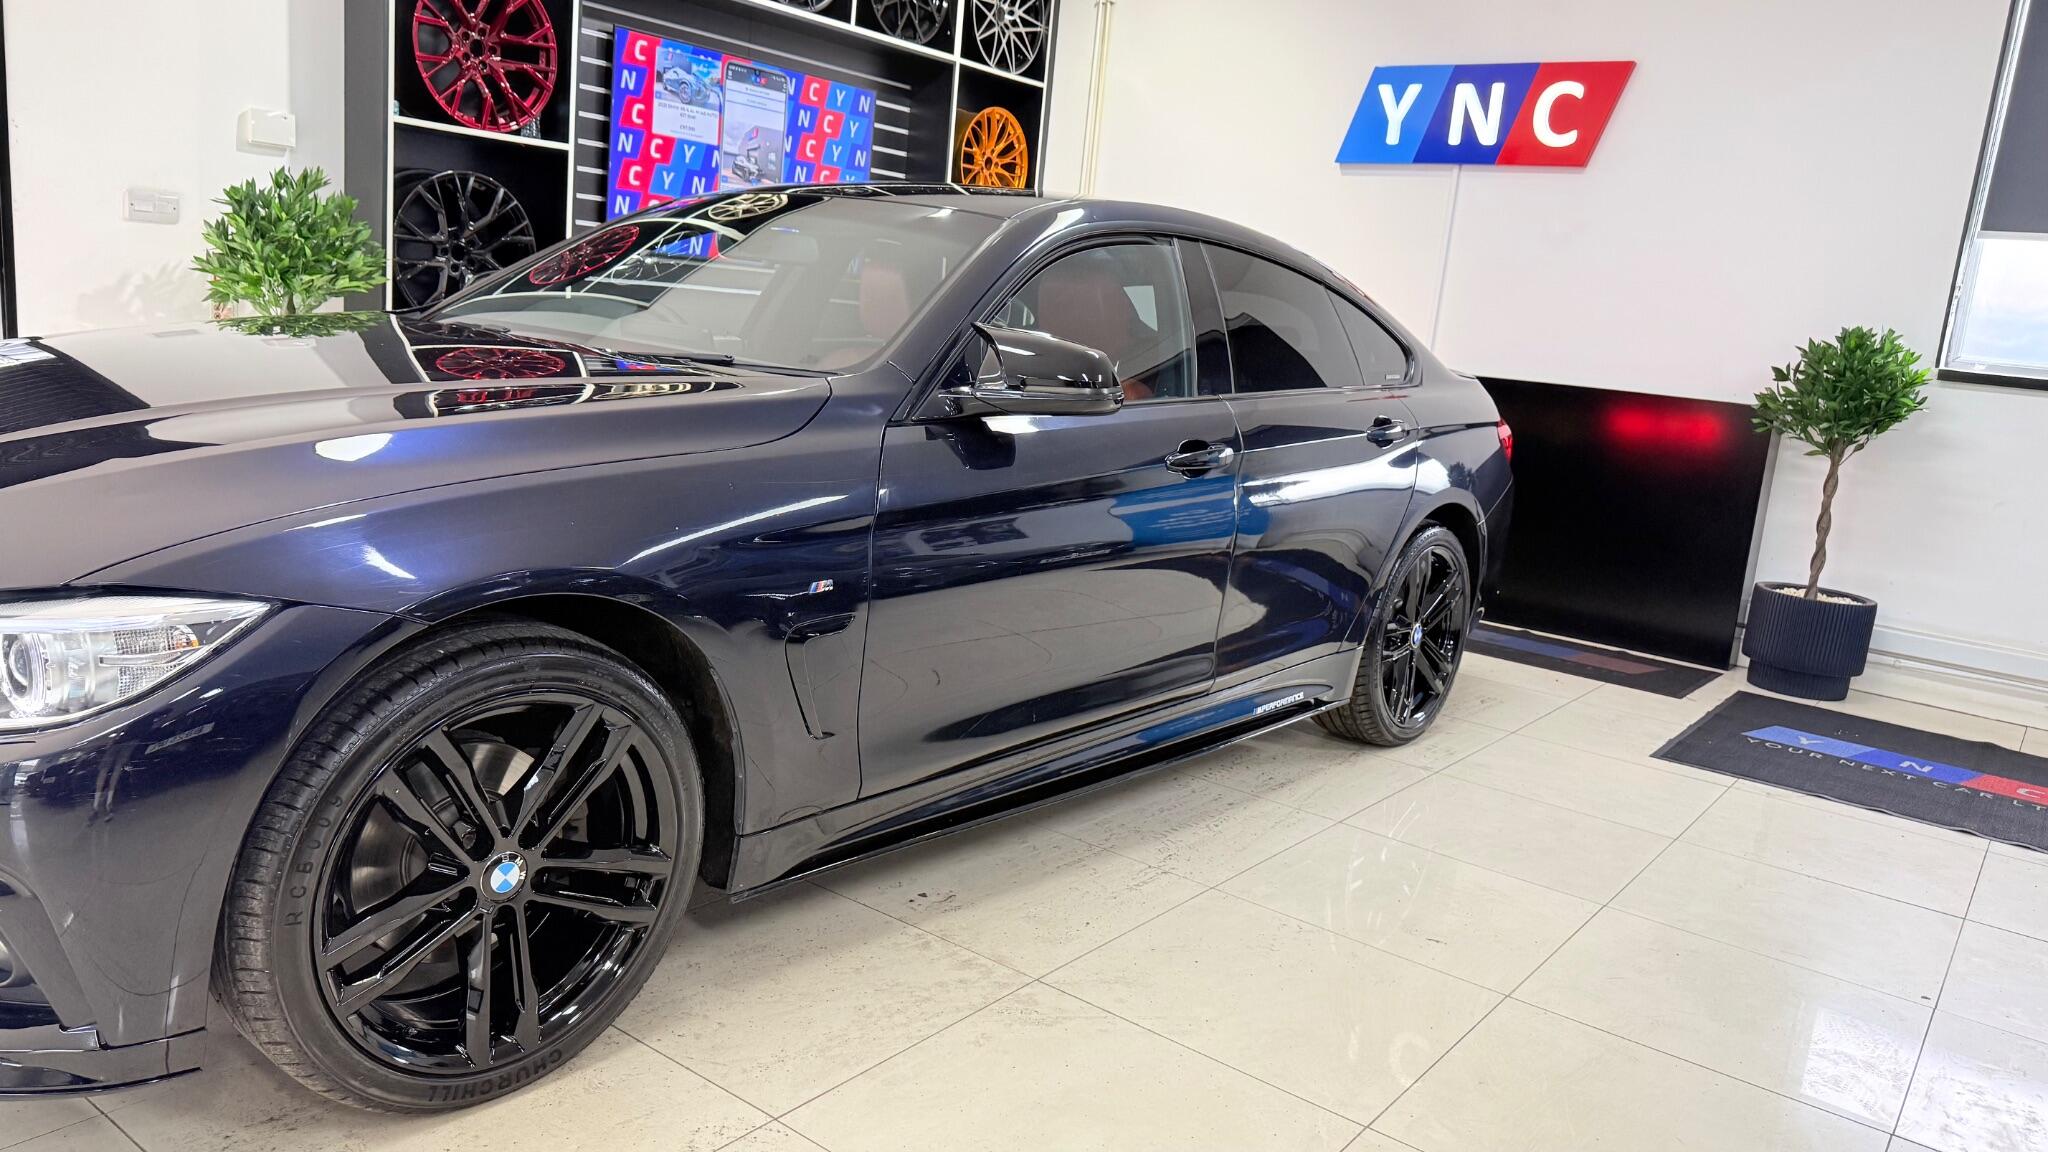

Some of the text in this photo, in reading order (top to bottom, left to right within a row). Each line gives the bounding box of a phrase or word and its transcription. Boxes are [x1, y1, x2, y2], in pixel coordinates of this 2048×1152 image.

[634, 39, 648, 61] C
[620, 68, 637, 91] N
[631, 103, 645, 125] C
[1377, 80, 1585, 148] YNC
[1747, 737, 1824, 760] YOUR
[1838, 758, 1917, 781] NEXT
[1932, 781, 1993, 800] CAR
[428, 1048, 563, 1102] CHURCHILL
